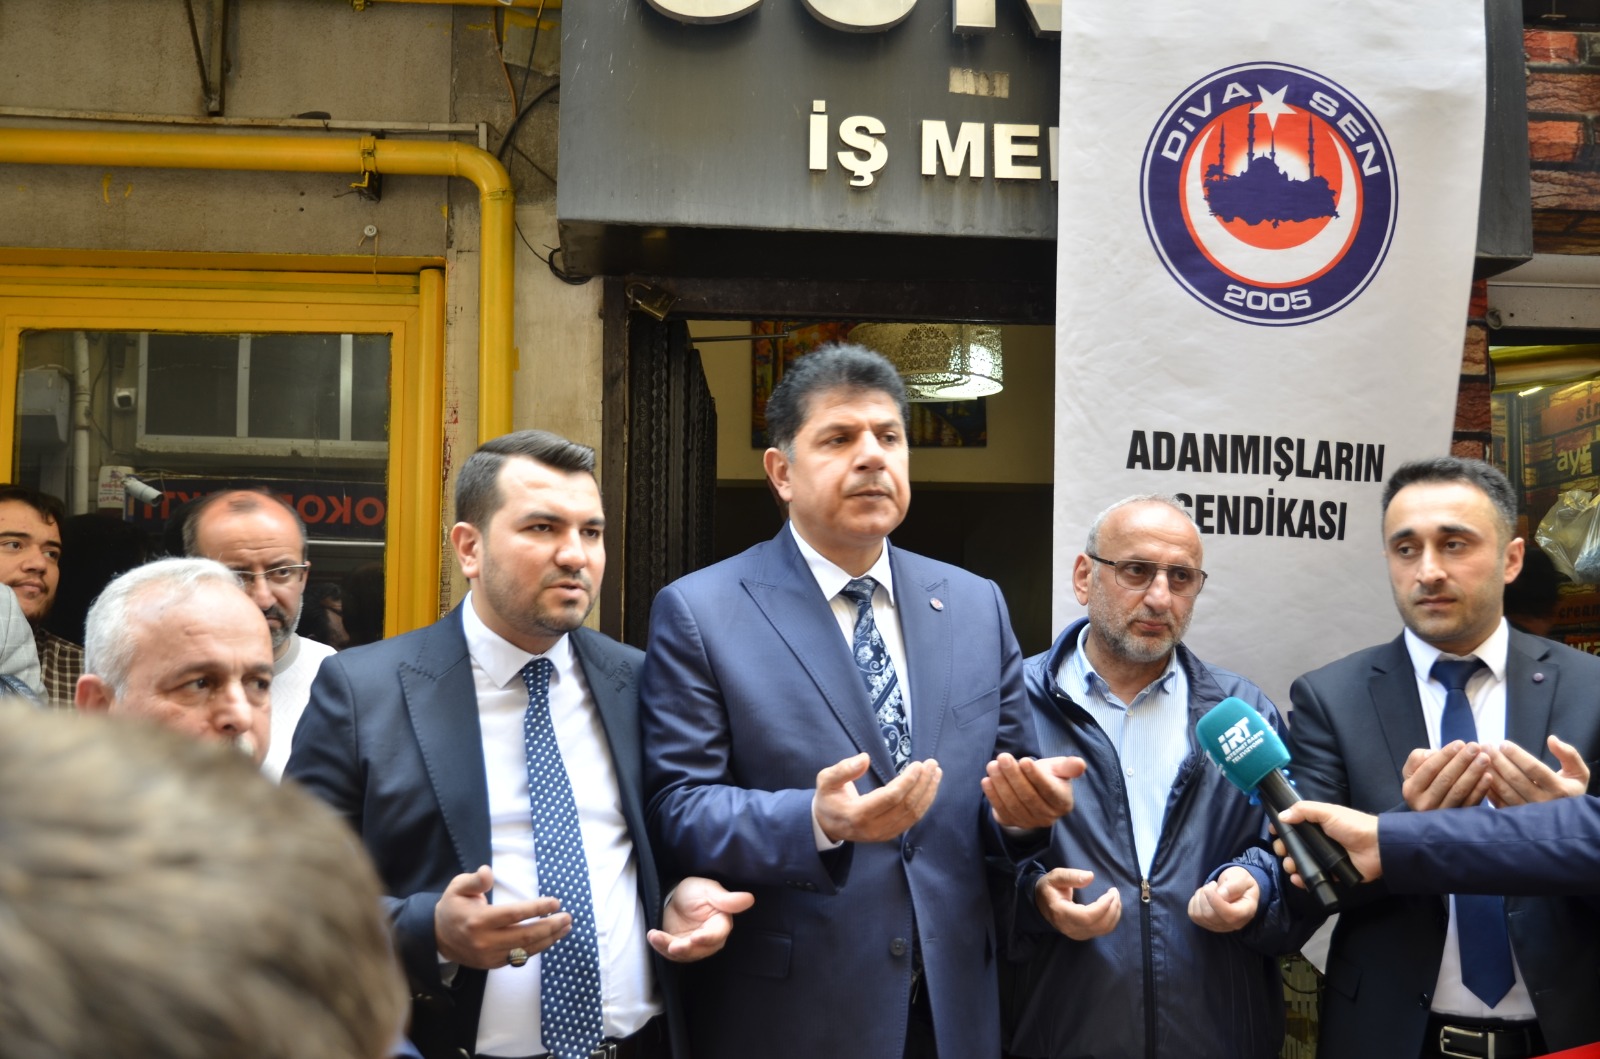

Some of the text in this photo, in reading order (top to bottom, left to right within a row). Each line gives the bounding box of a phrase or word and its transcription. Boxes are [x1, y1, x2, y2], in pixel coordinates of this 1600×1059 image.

[809, 100, 888, 187] İŞ
[1309, 91, 1381, 178] SEN
[1223, 284, 1312, 312] 2005
[1126, 430, 1386, 482] ADANMIŞLARIN
